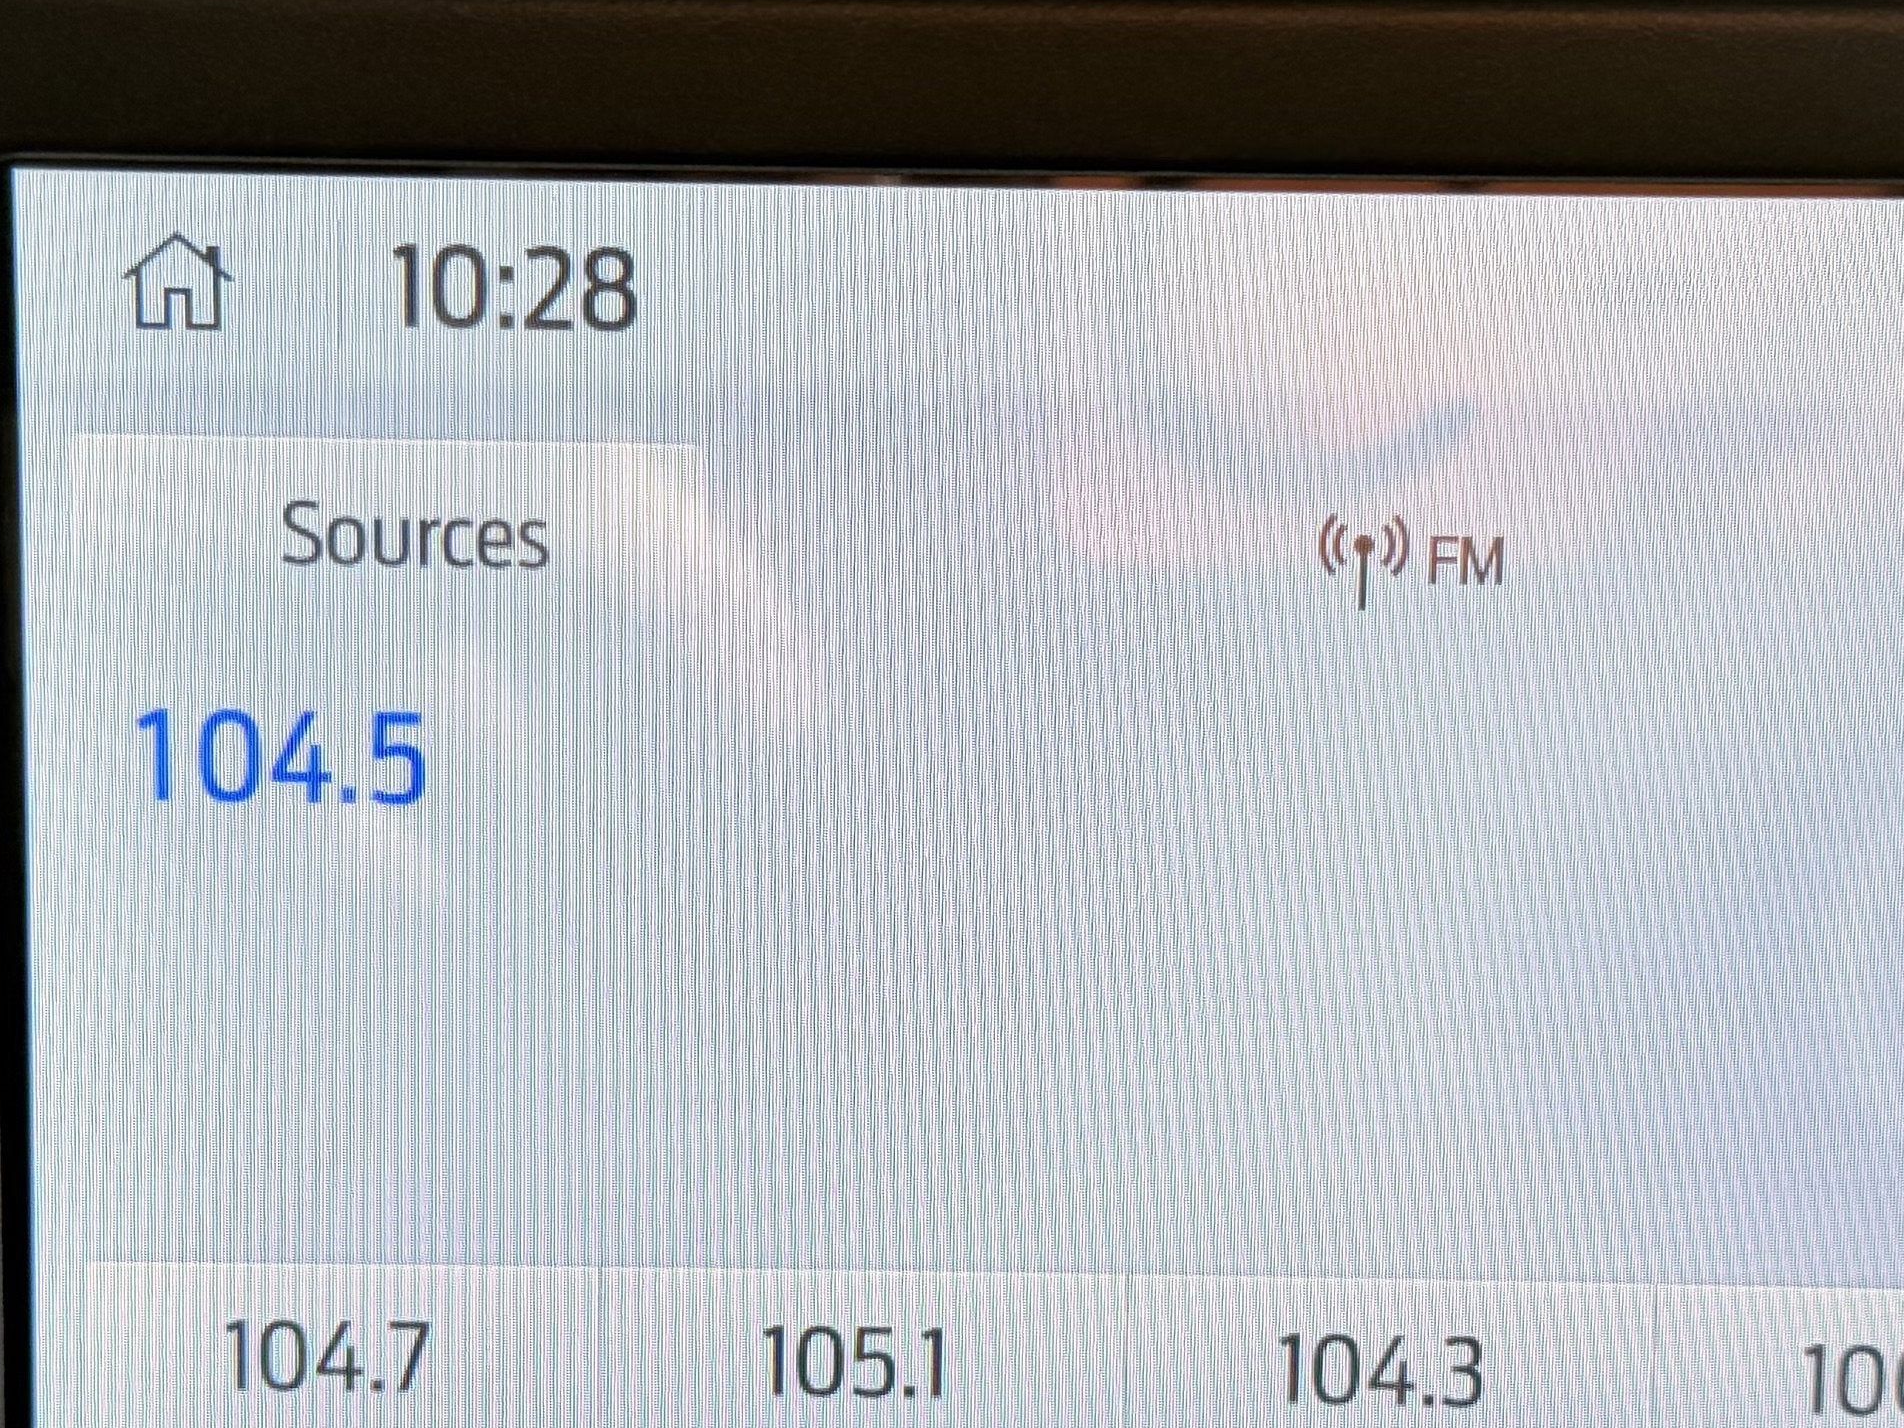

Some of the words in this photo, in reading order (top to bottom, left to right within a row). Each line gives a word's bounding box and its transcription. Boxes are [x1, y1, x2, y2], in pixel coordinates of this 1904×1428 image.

[392, 242, 639, 332] 10:28
[281, 500, 552, 570] Sources
[1427, 535, 1506, 586] FM
[134, 707, 428, 806] 104.5
[225, 1318, 432, 1394] 104.7
[761, 1324, 948, 1400] 105.1
[1278, 1332, 1485, 1408] 104.3
